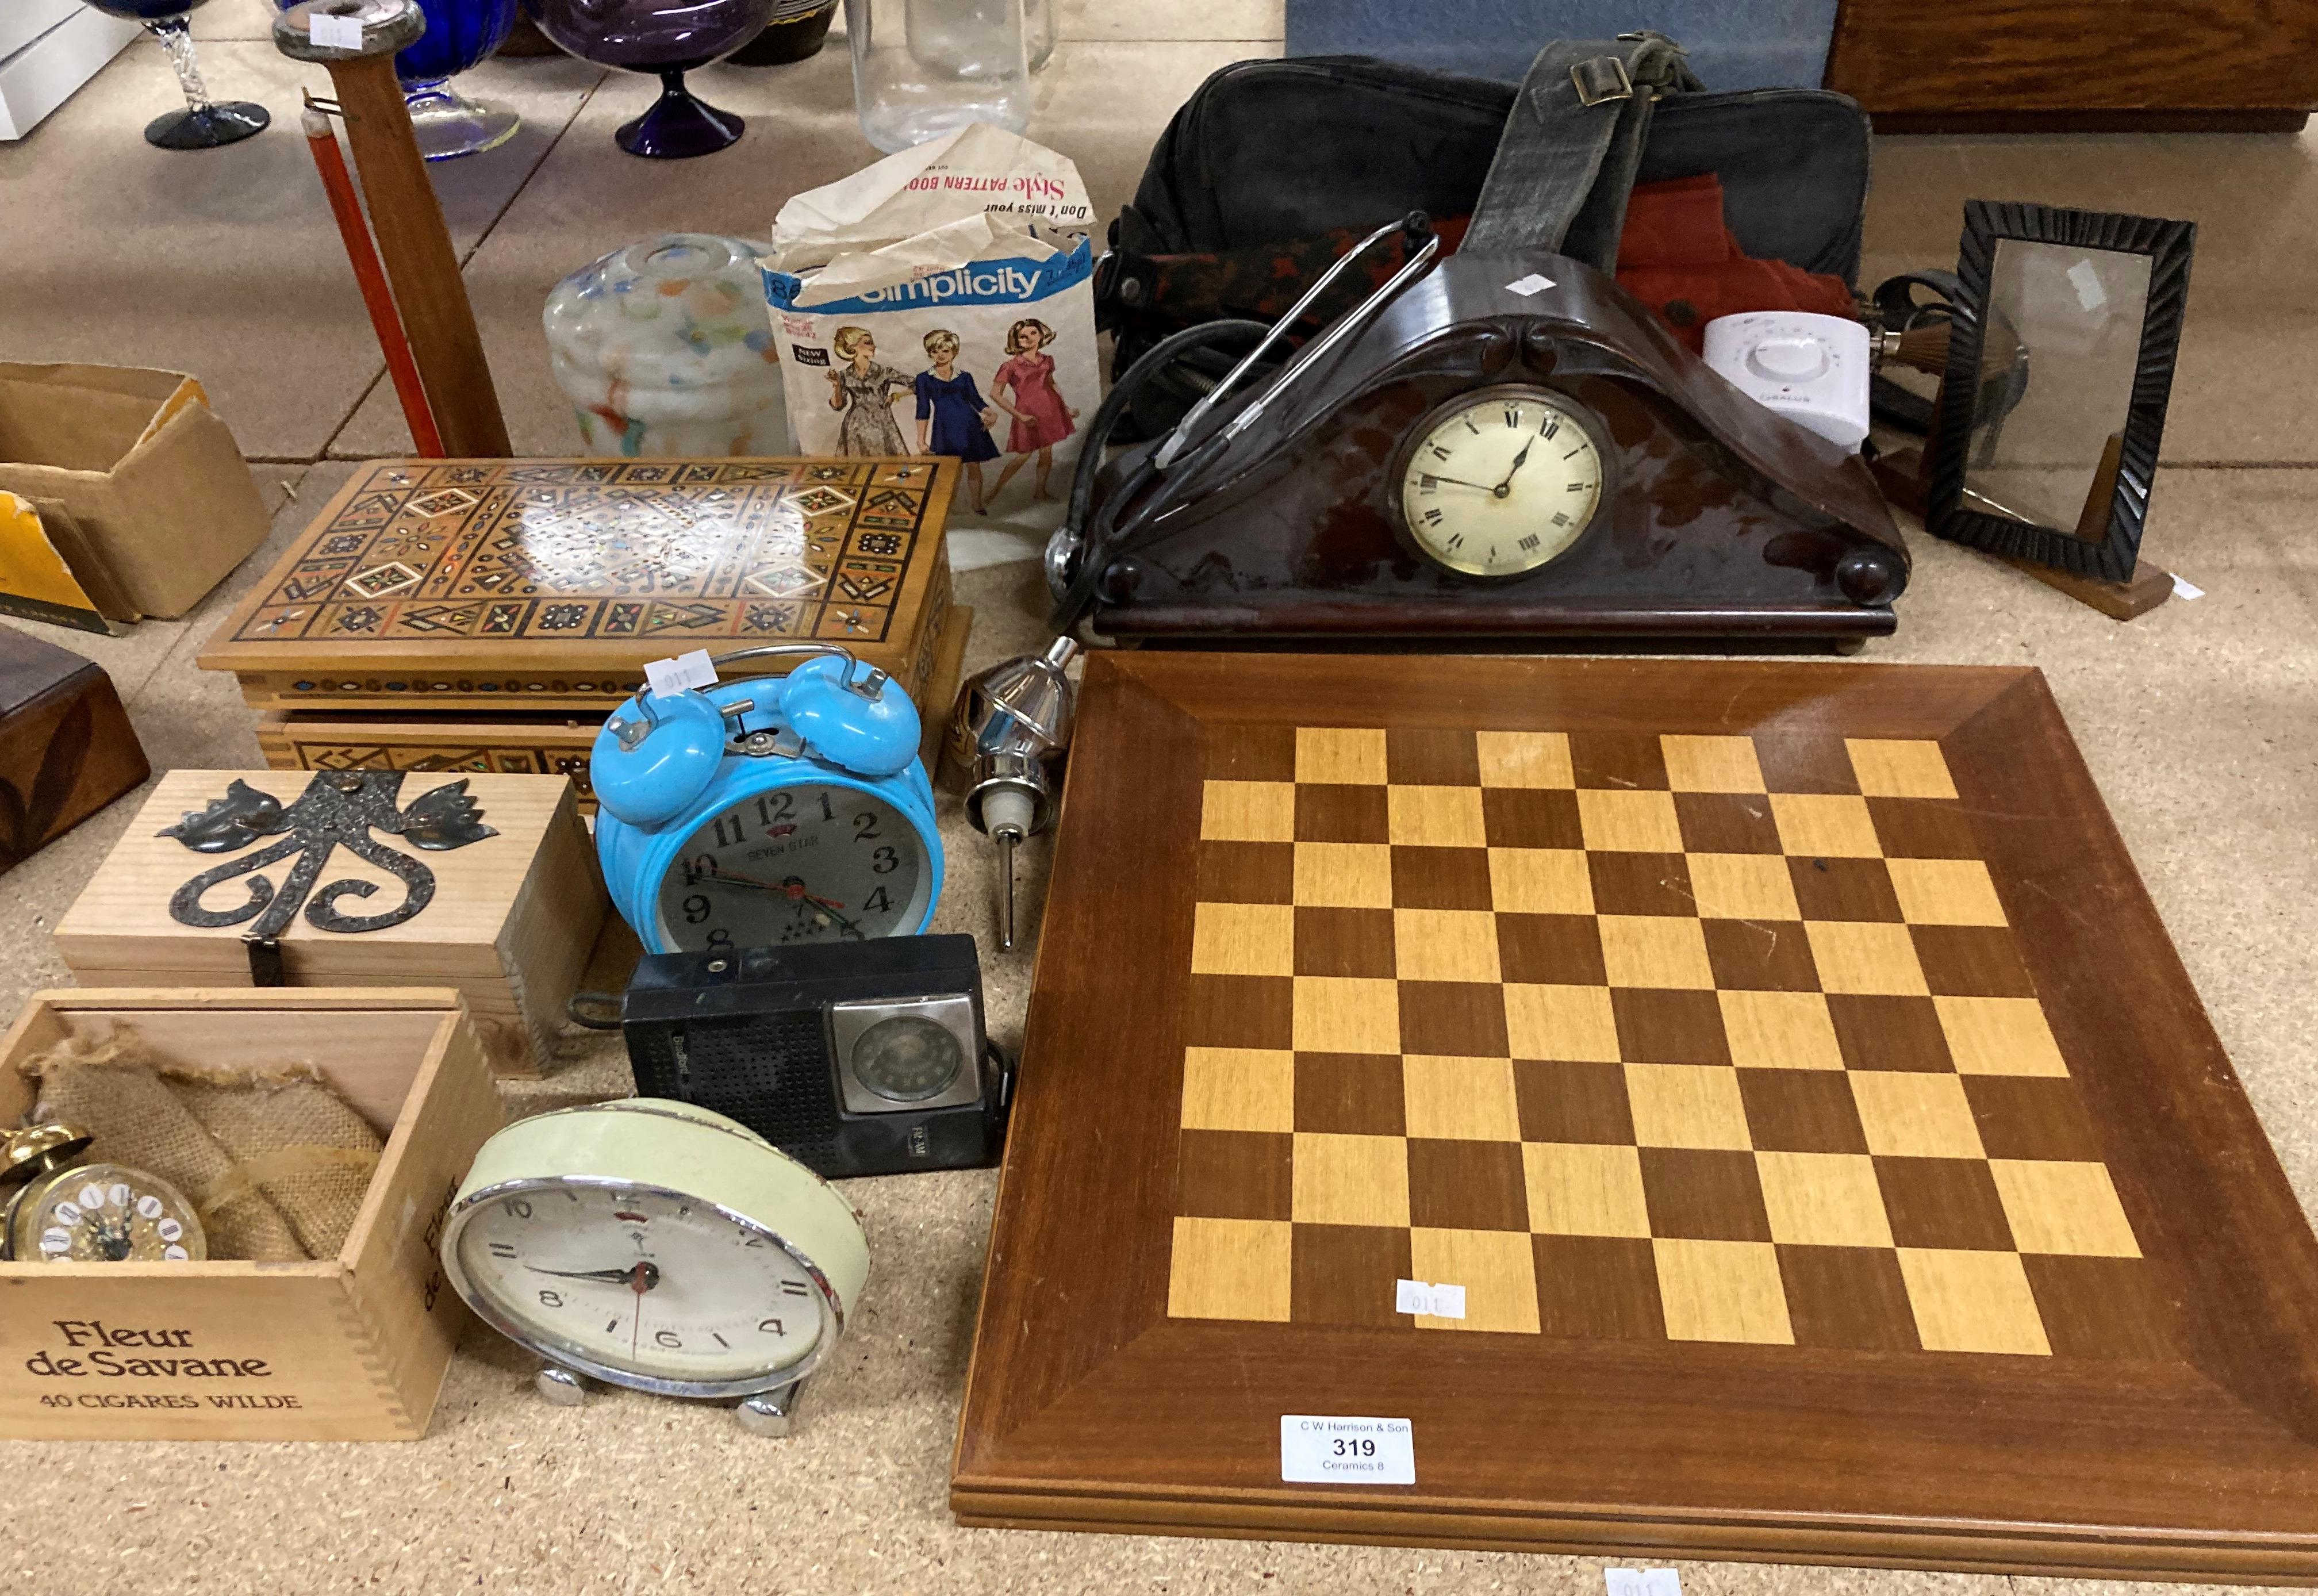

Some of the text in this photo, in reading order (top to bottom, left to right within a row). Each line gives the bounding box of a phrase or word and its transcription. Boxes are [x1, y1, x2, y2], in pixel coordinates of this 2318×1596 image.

[943, 176, 1008, 191] PATTERN
[1012, 172, 1065, 200] Style
[984, 202, 1087, 219] Don't miss your
[754, 792, 797, 826] 12
[818, 792, 835, 822] 1
[711, 814, 747, 849] 11
[853, 812, 882, 843] 2
[873, 845, 899, 873] 3
[682, 895, 711, 924] 9
[863, 886, 894, 913] 4
[501, 1197, 532, 1219] 10
[539, 1290, 564, 1309] 8
[52, 1321, 194, 1348] Fleur
[654, 1330, 682, 1348] 6
[758, 1318, 788, 1337] 4
[26, 1351, 272, 1377] de Savane
[40, 1395, 303, 1409] 40 CIGARES WILDE
[1300, 1421, 1409, 1433] C W Harrison & Son
[1333, 1438, 1376, 1457] 319
[1322, 1460, 1374, 1471] Ceramics
